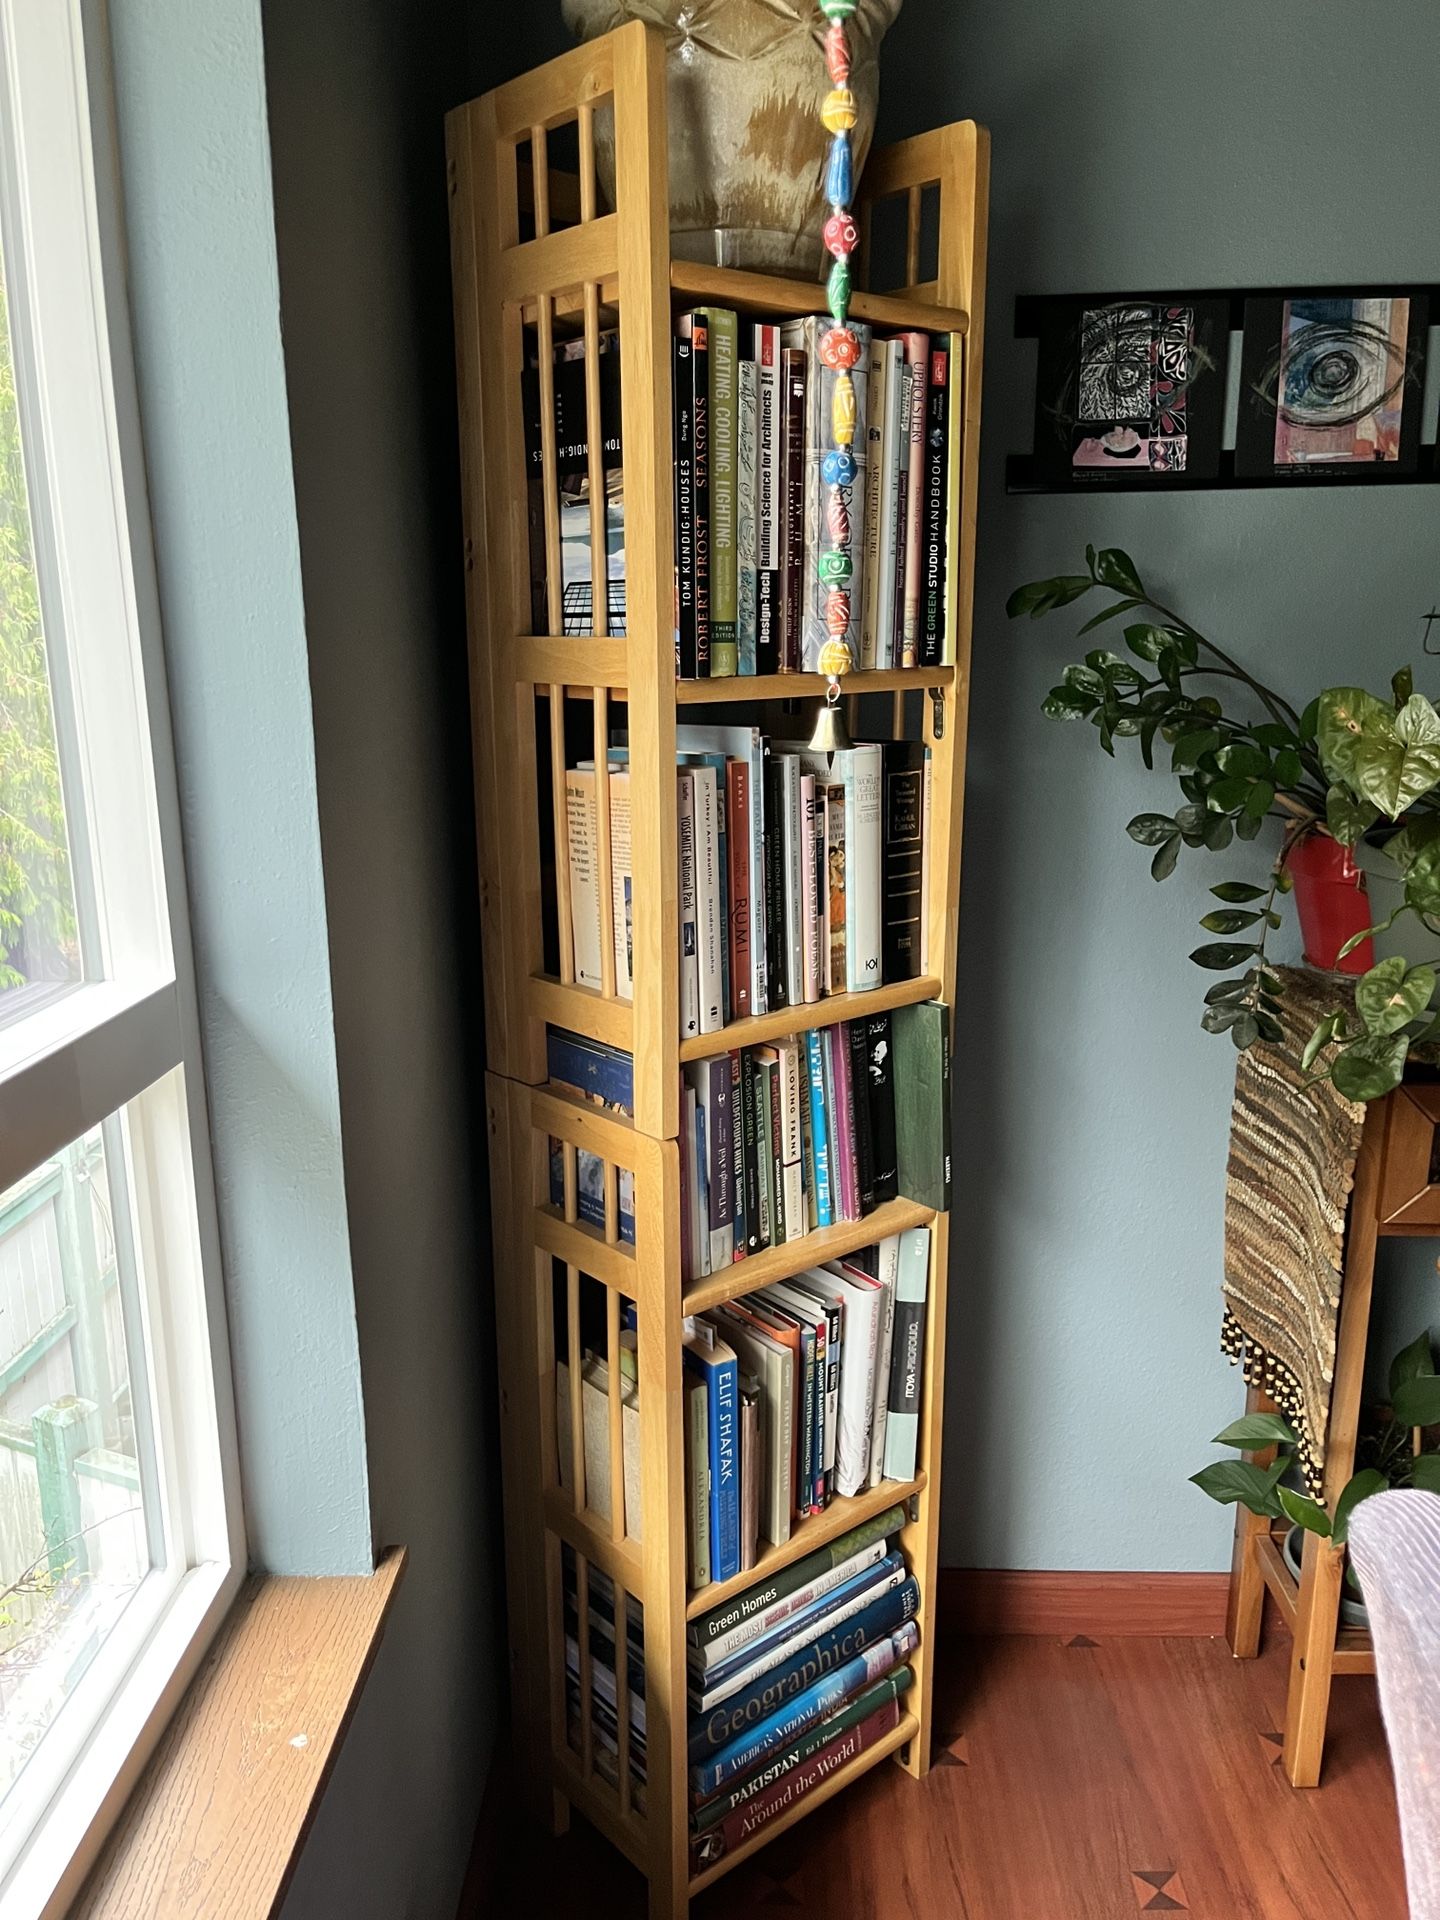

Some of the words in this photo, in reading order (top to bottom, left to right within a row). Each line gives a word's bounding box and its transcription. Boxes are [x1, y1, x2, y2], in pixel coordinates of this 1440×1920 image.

[715, 333, 732, 404] HEATING,
[760, 389, 772, 450] Architects
[911, 361, 926, 444] UPHOLSTERY
[695, 397, 707, 488] SEASONS
[714, 406, 731, 477] COOLING,
[760, 452, 772, 468] for
[760, 470, 772, 518] Science
[900, 472, 908, 497] beads
[930, 454, 943, 542] HANDBOOK
[680, 459, 691, 574] KUNDIG:HOUSES
[714, 481, 731, 548] LIGHTING
[870, 463, 880, 559] ARCHITECTURE
[890, 500, 898, 556] BEACON
[898, 515, 907, 545] jewelry
[696, 514, 708, 577] FROST
[760, 519, 773, 568] Building
[898, 545, 906, 567] felted
[897, 568, 905, 589] hand
[928, 544, 939, 589] STUDIO
[682, 581, 692, 608] TOM
[760, 571, 771, 644] Design-Tech
[928, 590, 937, 631] GREEN
[696, 585, 709, 661] ROBERT
[926, 633, 936, 657] THE
[704, 782, 710, 790] In
[805, 798, 815, 822] 101
[680, 815, 692, 854] YOSEMITE
[706, 830, 712, 844] Am
[681, 855, 693, 891] National
[808, 829, 818, 925] BEST-LOVED
[682, 891, 693, 910] Park
[733, 897, 748, 955] RUMI
[811, 930, 820, 980] POEMS
[731, 1058, 740, 1079] BEST
[744, 1054, 753, 1112] EXPLOSION
[755, 1086, 765, 1139] SEATTLE
[771, 1074, 780, 1113] Perfect
[789, 1069, 797, 1115] LOVING
[800, 1073, 811, 1126] ISHMAEL
[732, 1088, 743, 1149] WILDFLOWER
[746, 1112, 754, 1146] GREEN
[773, 1113, 781, 1156] Victims
[789, 1118, 798, 1159] FRANK
[718, 1147, 727, 1165] Veil
[733, 1150, 743, 1176] HIKES
[758, 1142, 768, 1190] STAIRWAY
[852, 1155, 858, 1165] OF
[718, 1169, 729, 1208] Through
[735, 1176, 744, 1216] Washington
[774, 1158, 782, 1198] MOHAMMED
[718, 1208, 727, 1219] As
[775, 1197, 784, 1225] EL-KURD
[807, 1339, 815, 1361] HIDDEN
[718, 1372, 732, 1408] ELIF
[818, 1361, 826, 1391] MOUNT
[905, 1373, 916, 1398] ITOYA
[805, 1390, 814, 1424] WESTERN
[817, 1392, 825, 1427] RAINIER
[718, 1413, 733, 1485] SHAFAK
[804, 1424, 813, 1476] WASHINGTON
[697, 1471, 706, 1542] ALEXANDRIA
[708, 1608, 740, 1637] Green
[741, 1586, 778, 1617] Homes
[722, 1633, 743, 1651] THE
[739, 1619, 766, 1641] MOST
[821, 1563, 859, 1591] AMERICA
[707, 1625, 866, 1745] Geographica
[730, 1731, 774, 1771] AMERICA'S
[774, 1705, 817, 1739] NATIONAL
[816, 1688, 844, 1711] PARKS
[819, 1696, 850, 1720] INDIA
[729, 1750, 800, 1809] PAKISTAN
[740, 1785, 794, 1837] Around
[794, 1772, 816, 1795] the
[815, 1738, 855, 1778] World
[749, 1800, 764, 1816] The
